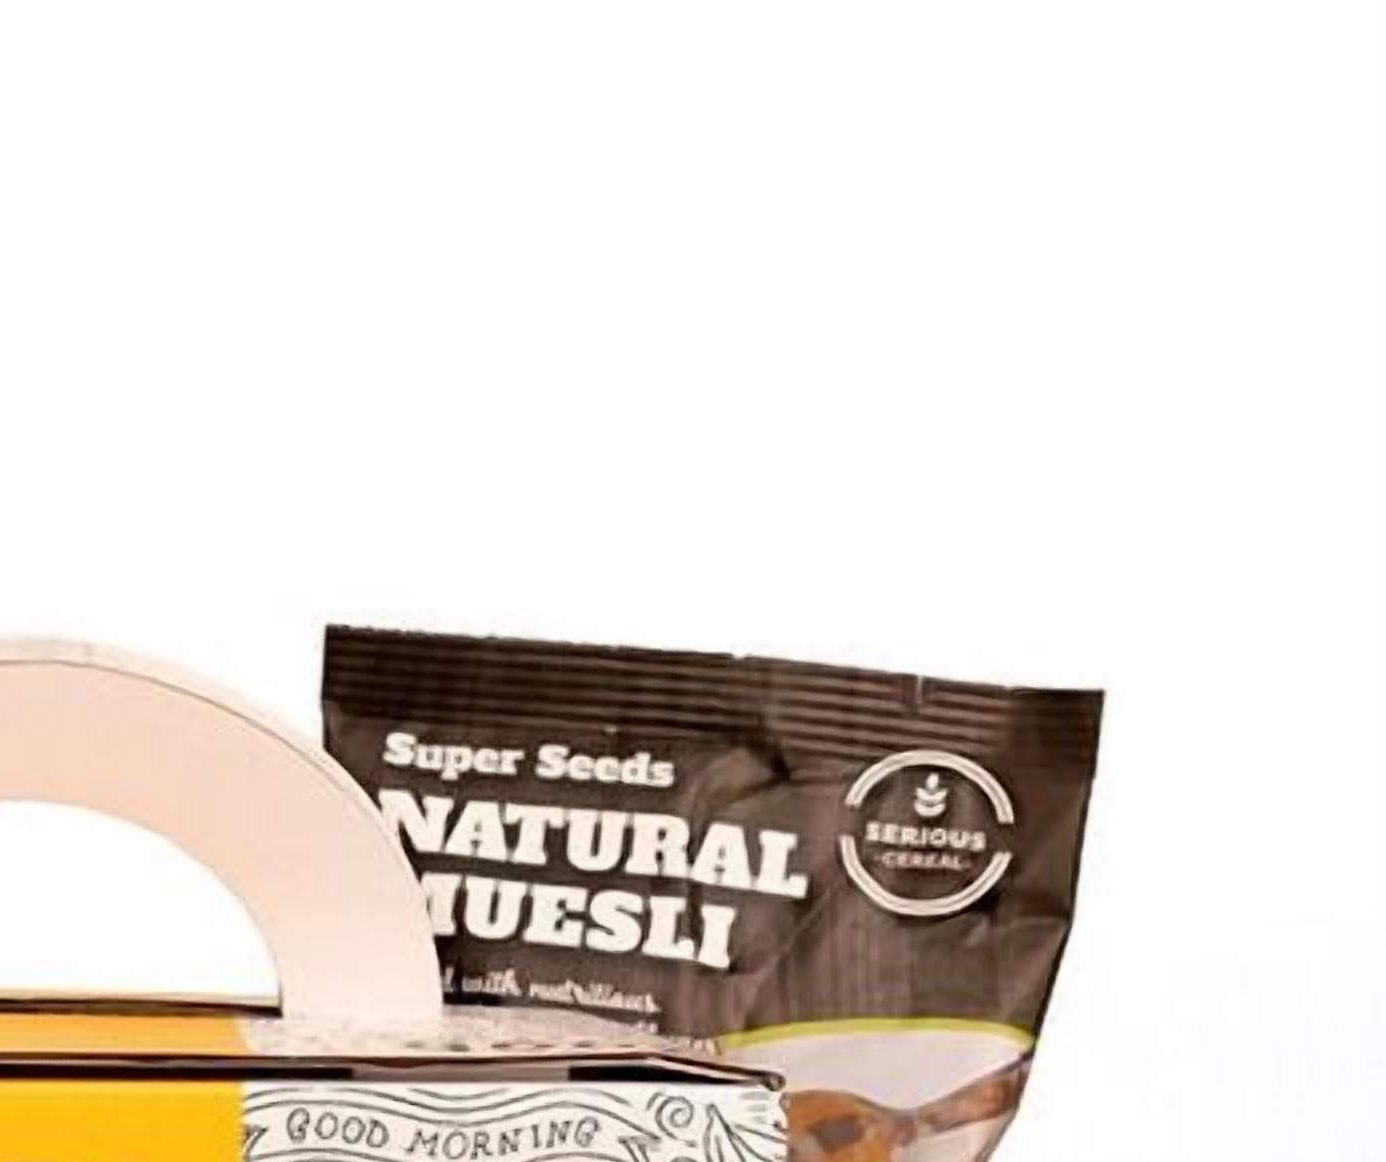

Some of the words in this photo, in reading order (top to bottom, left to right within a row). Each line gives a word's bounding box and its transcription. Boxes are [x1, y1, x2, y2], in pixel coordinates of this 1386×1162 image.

[382, 732, 525, 780] Super
[536, 744, 675, 788] Seeds
[378, 788, 808, 899] NATURAL
[866, 821, 986, 851] SERIOUS
[882, 852, 963, 870] CEREAL
[286, 1107, 389, 1149] GOOD
[408, 1116, 601, 1160] MORNING
